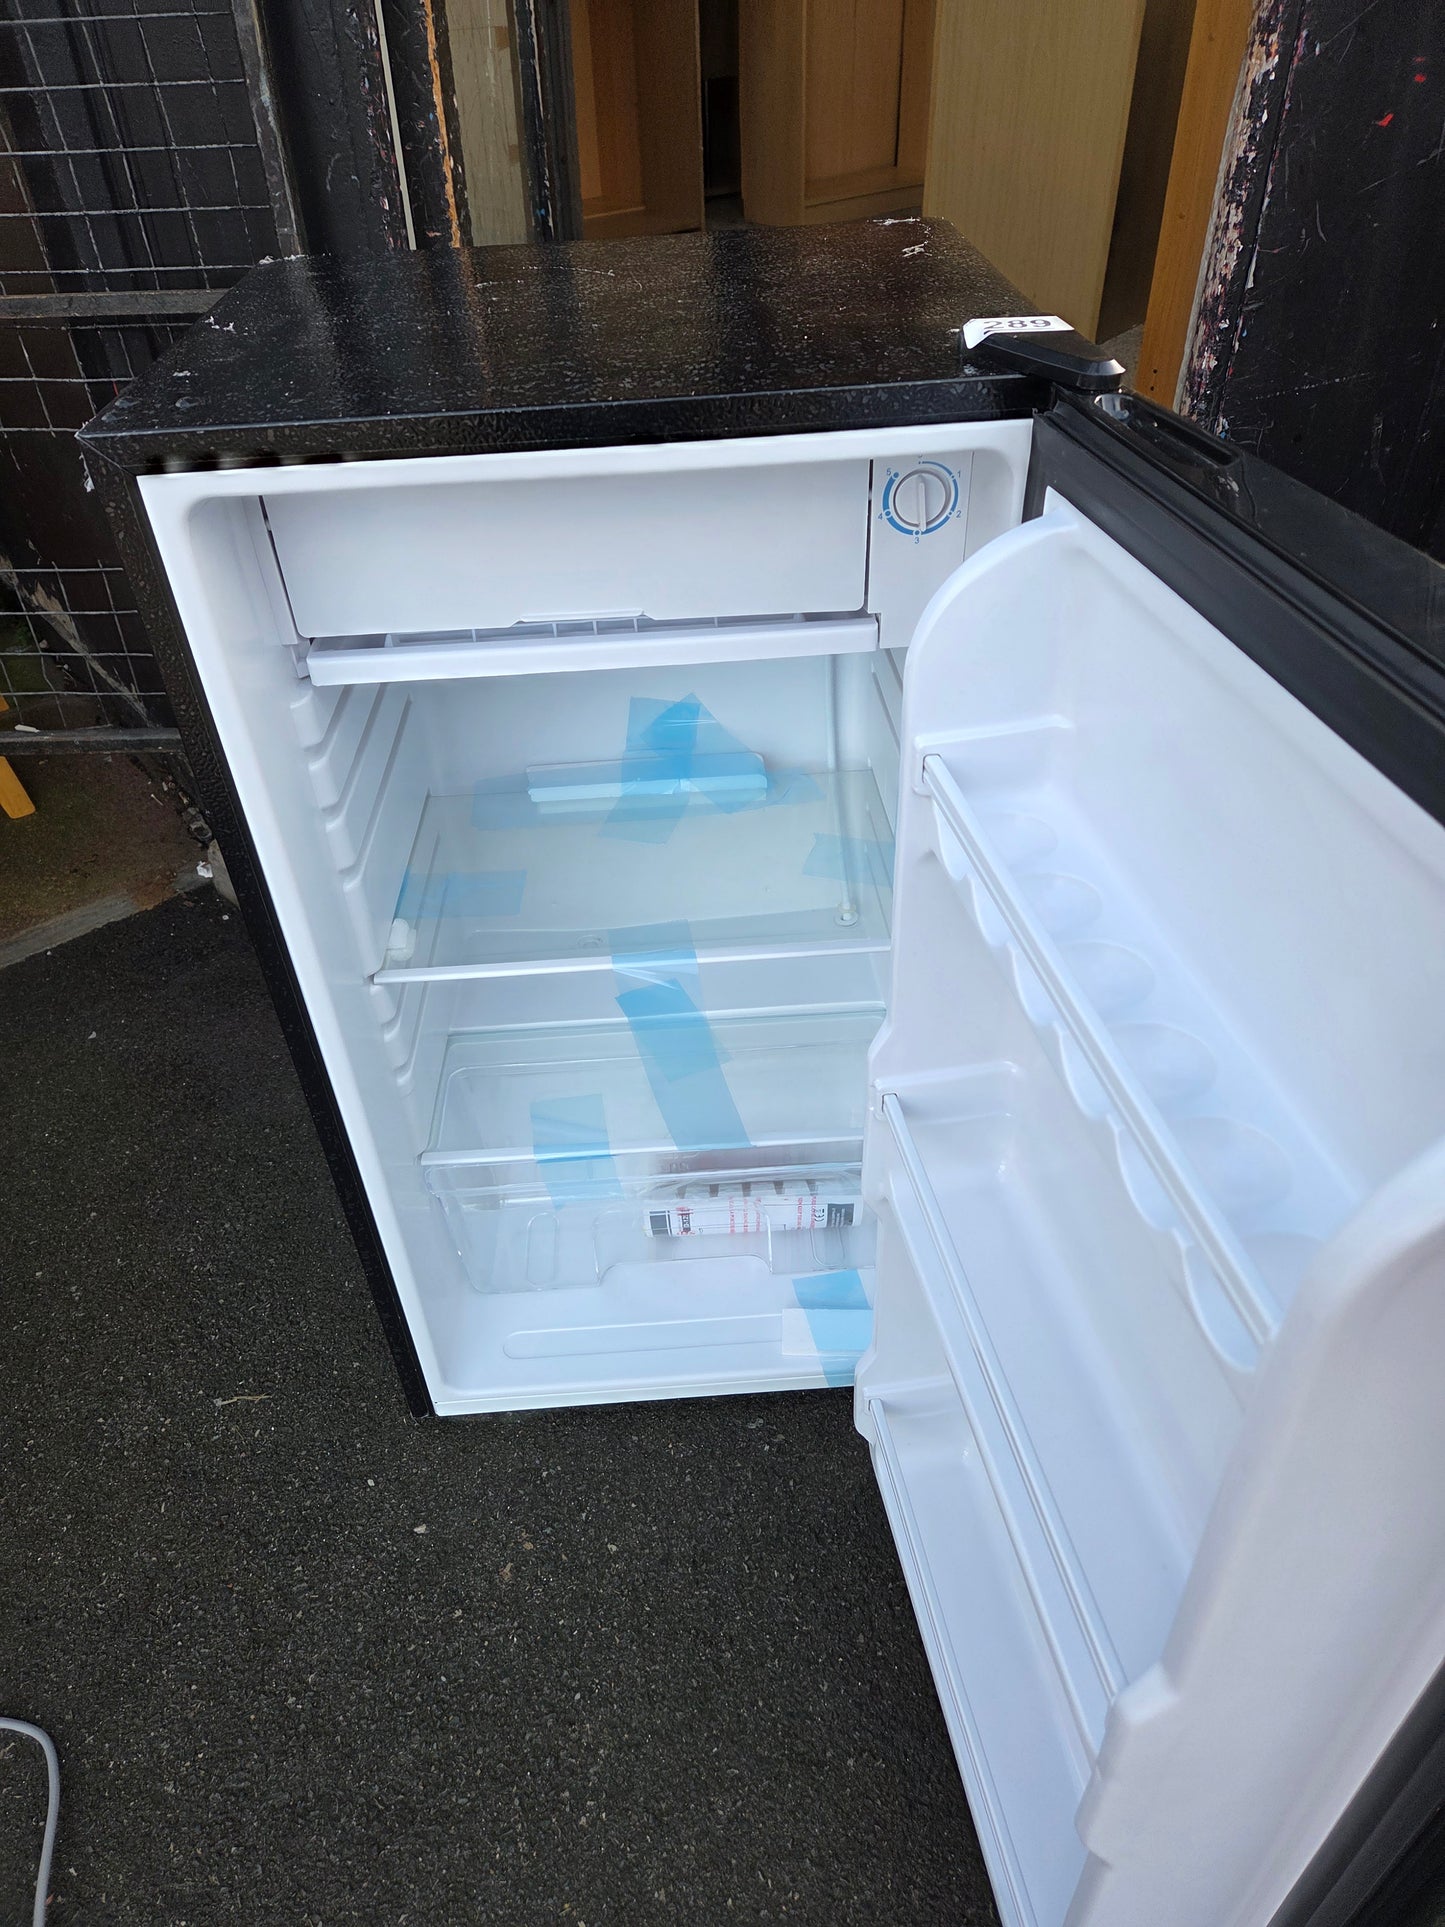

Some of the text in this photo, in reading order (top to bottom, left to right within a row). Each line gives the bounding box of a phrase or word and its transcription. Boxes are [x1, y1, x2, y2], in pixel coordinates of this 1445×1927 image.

[984, 319, 1051, 330] 289
[886, 467, 892, 476] 5
[877, 513, 883, 521] 4
[956, 510, 962, 519] 2
[914, 536, 920, 545] 3
